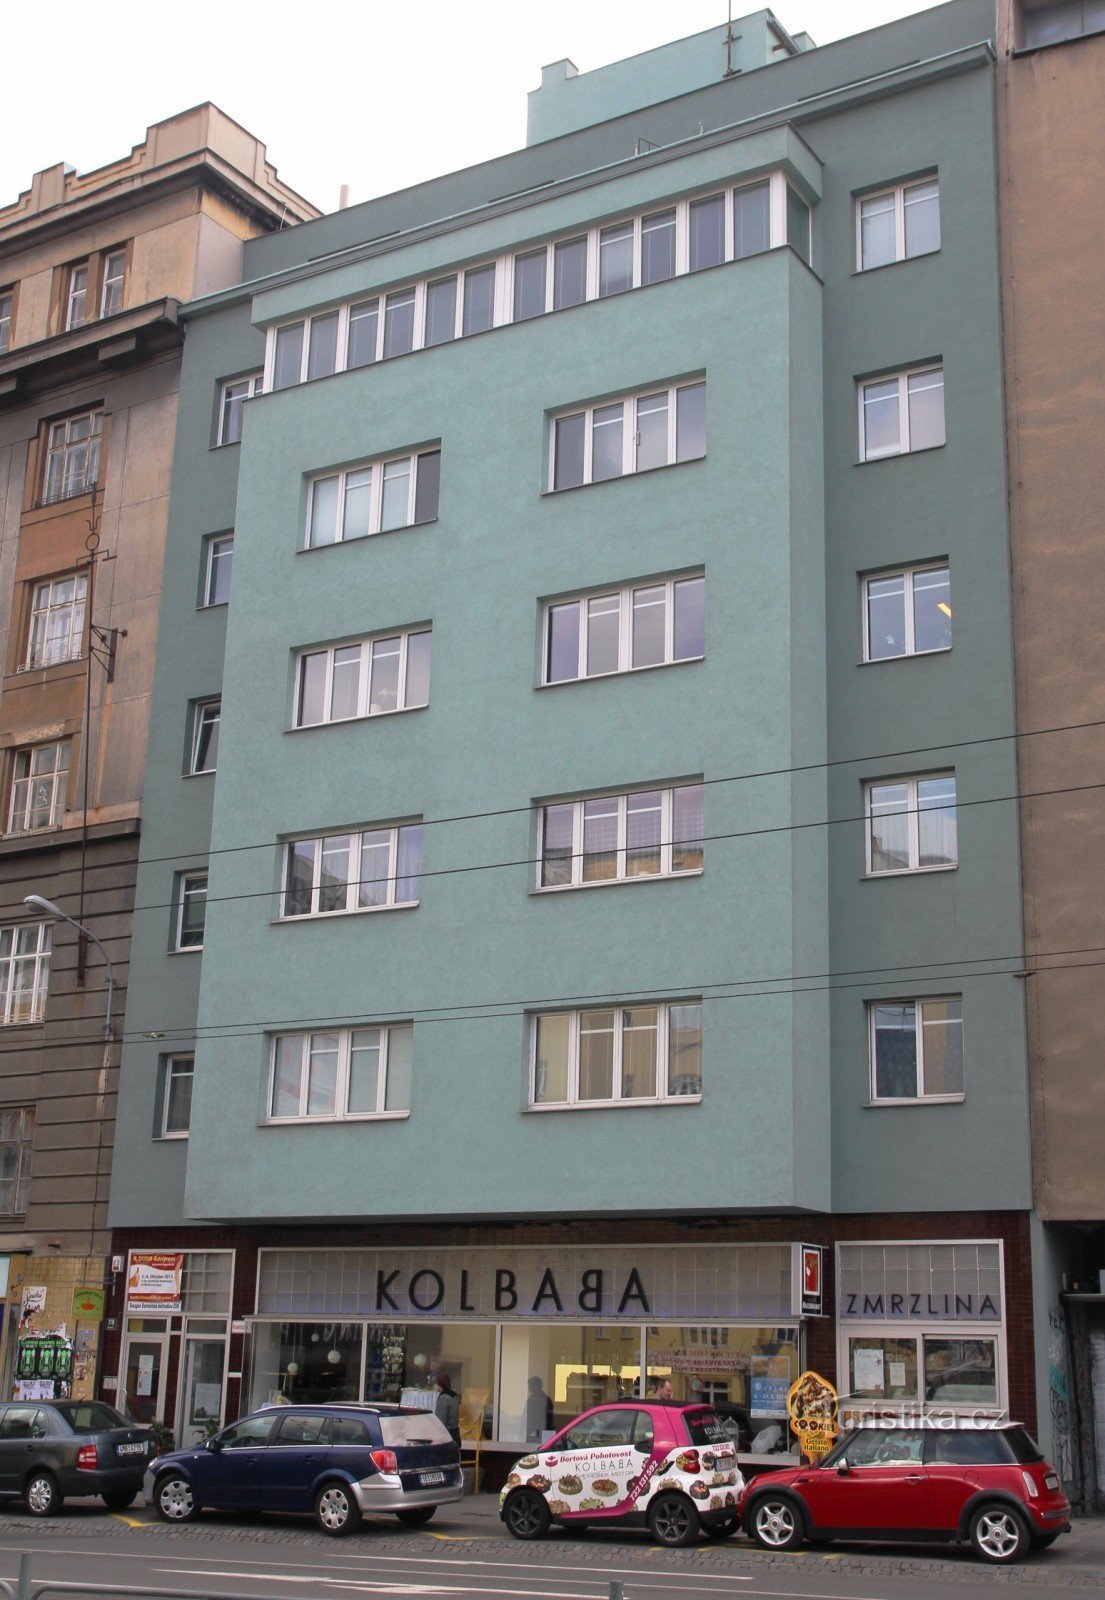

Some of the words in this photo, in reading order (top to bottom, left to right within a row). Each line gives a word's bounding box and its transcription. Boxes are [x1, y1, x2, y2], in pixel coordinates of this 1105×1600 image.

[375, 1267, 650, 1313] KOLBABA
[846, 1293, 998, 1316] ZMRZLINA
[803, 1444, 830, 1452] italiano
[805, 1437, 828, 1446] Gelato
[560, 1455, 588, 1463] Dortová
[590, 1450, 632, 1460] Pohotovost
[575, 1459, 634, 1473] KOLBABA
